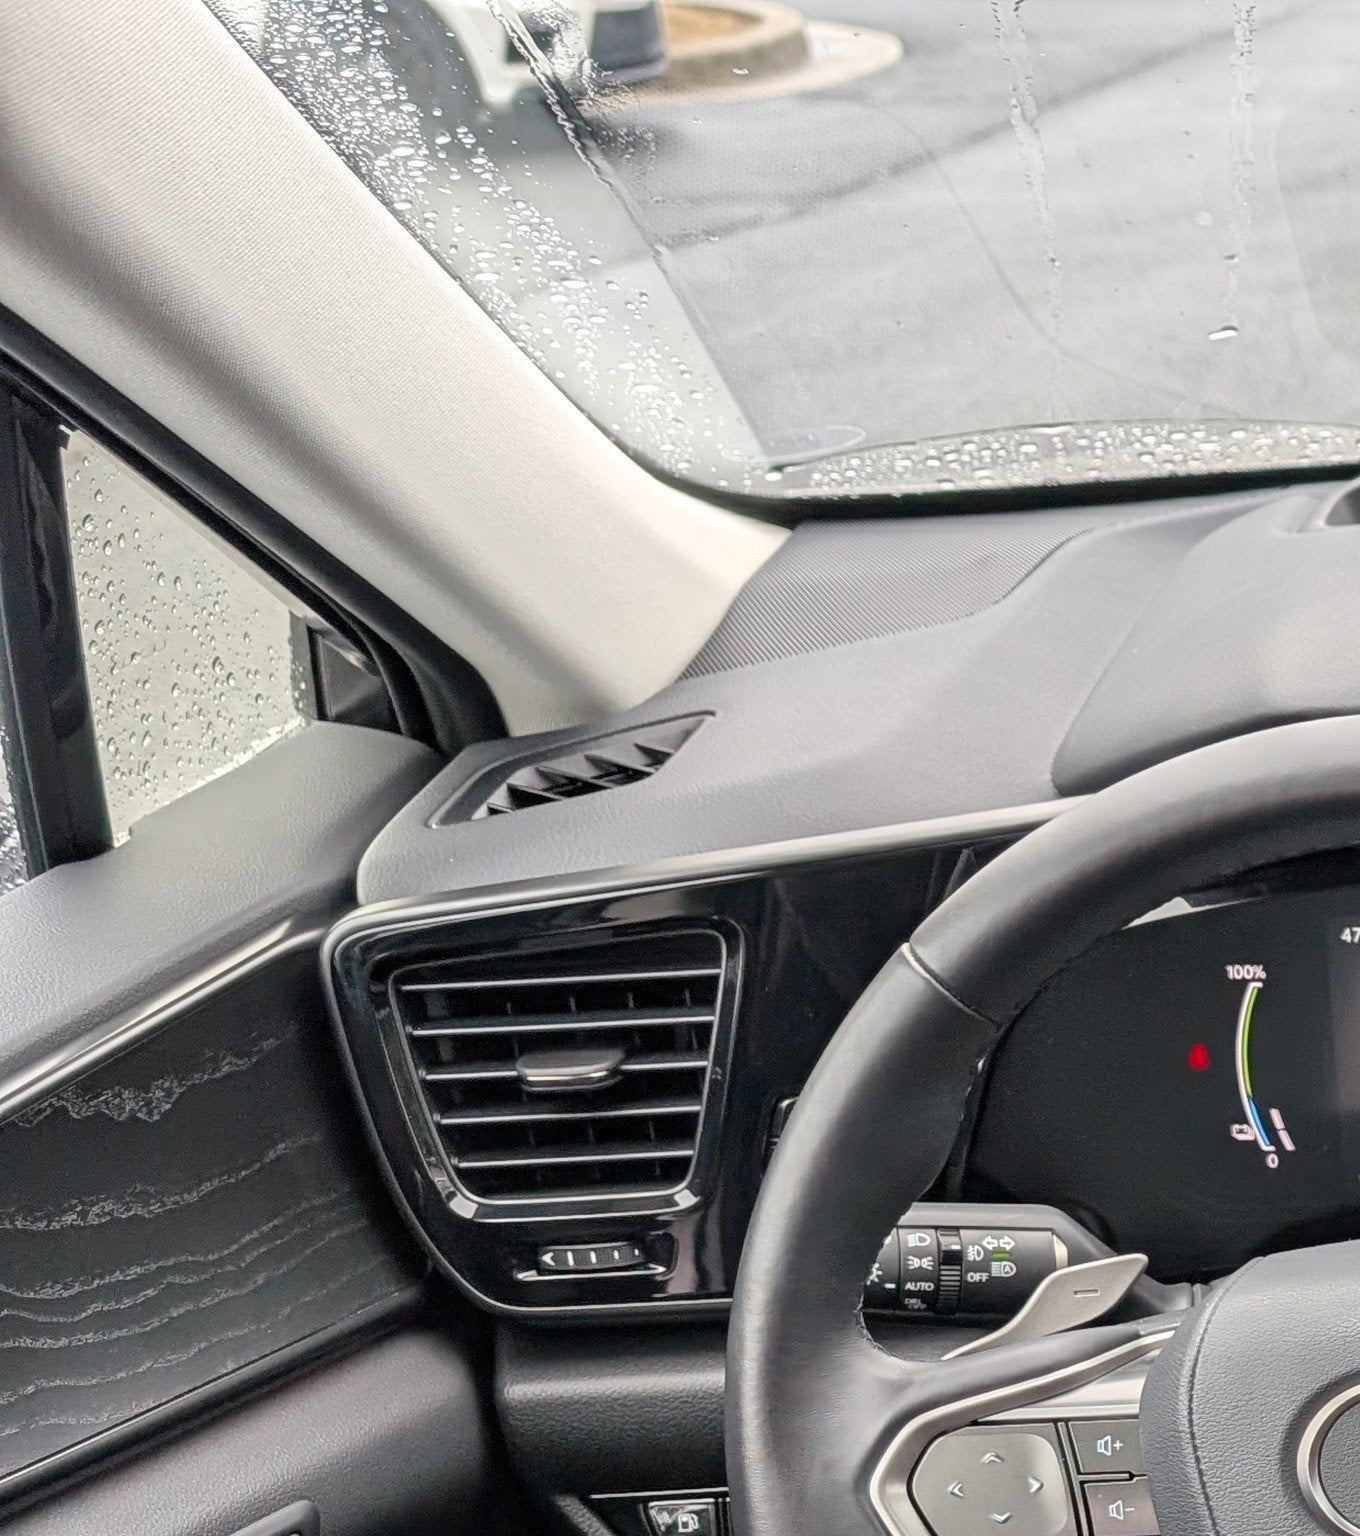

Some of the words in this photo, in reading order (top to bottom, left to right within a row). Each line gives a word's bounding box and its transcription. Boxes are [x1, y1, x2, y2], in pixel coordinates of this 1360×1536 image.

[1225, 964, 1267, 980] 100%
[1266, 1153, 1279, 1169] 0
[966, 1272, 990, 1282] OFF
[904, 1281, 935, 1291] AUTO
